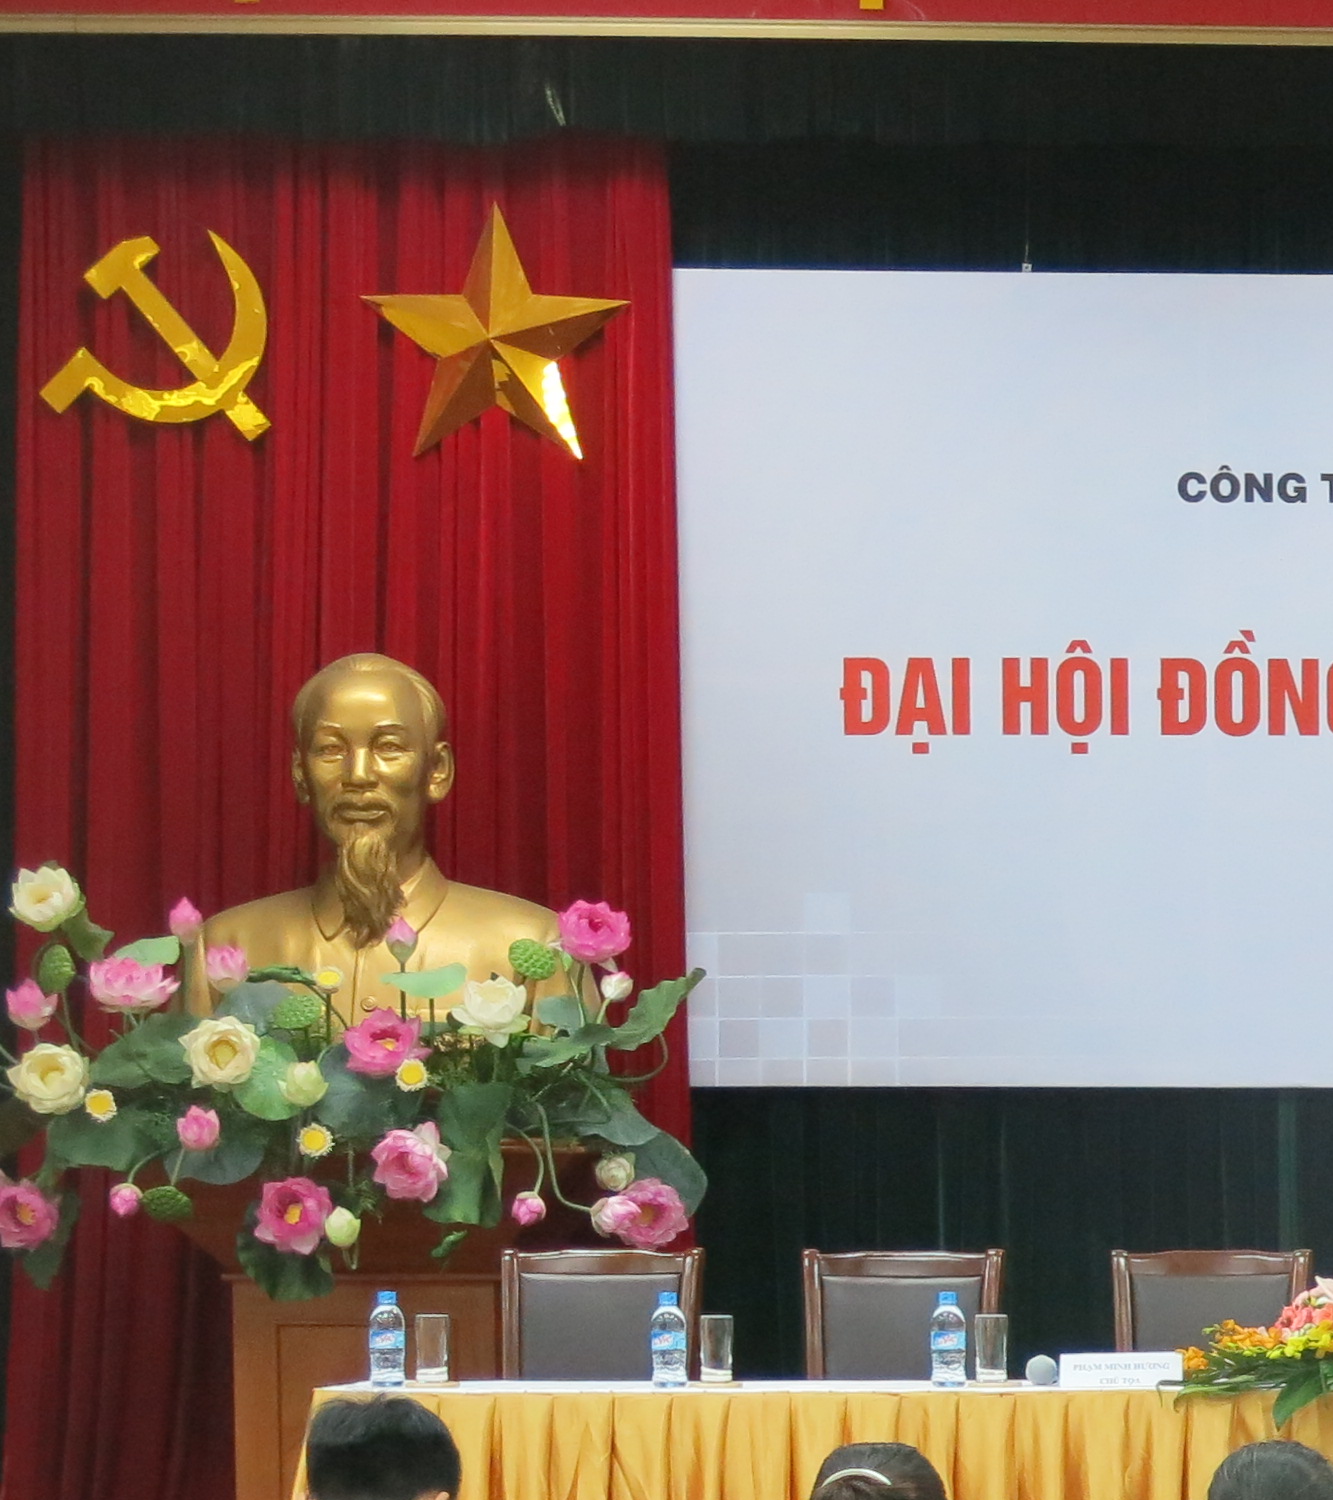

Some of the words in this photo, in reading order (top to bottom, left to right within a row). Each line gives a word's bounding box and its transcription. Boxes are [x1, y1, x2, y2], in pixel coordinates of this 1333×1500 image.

[1178, 465, 1307, 504] CÔNG
[841, 658, 970, 753] ĐẠI
[1004, 641, 1128, 753] HỘI
